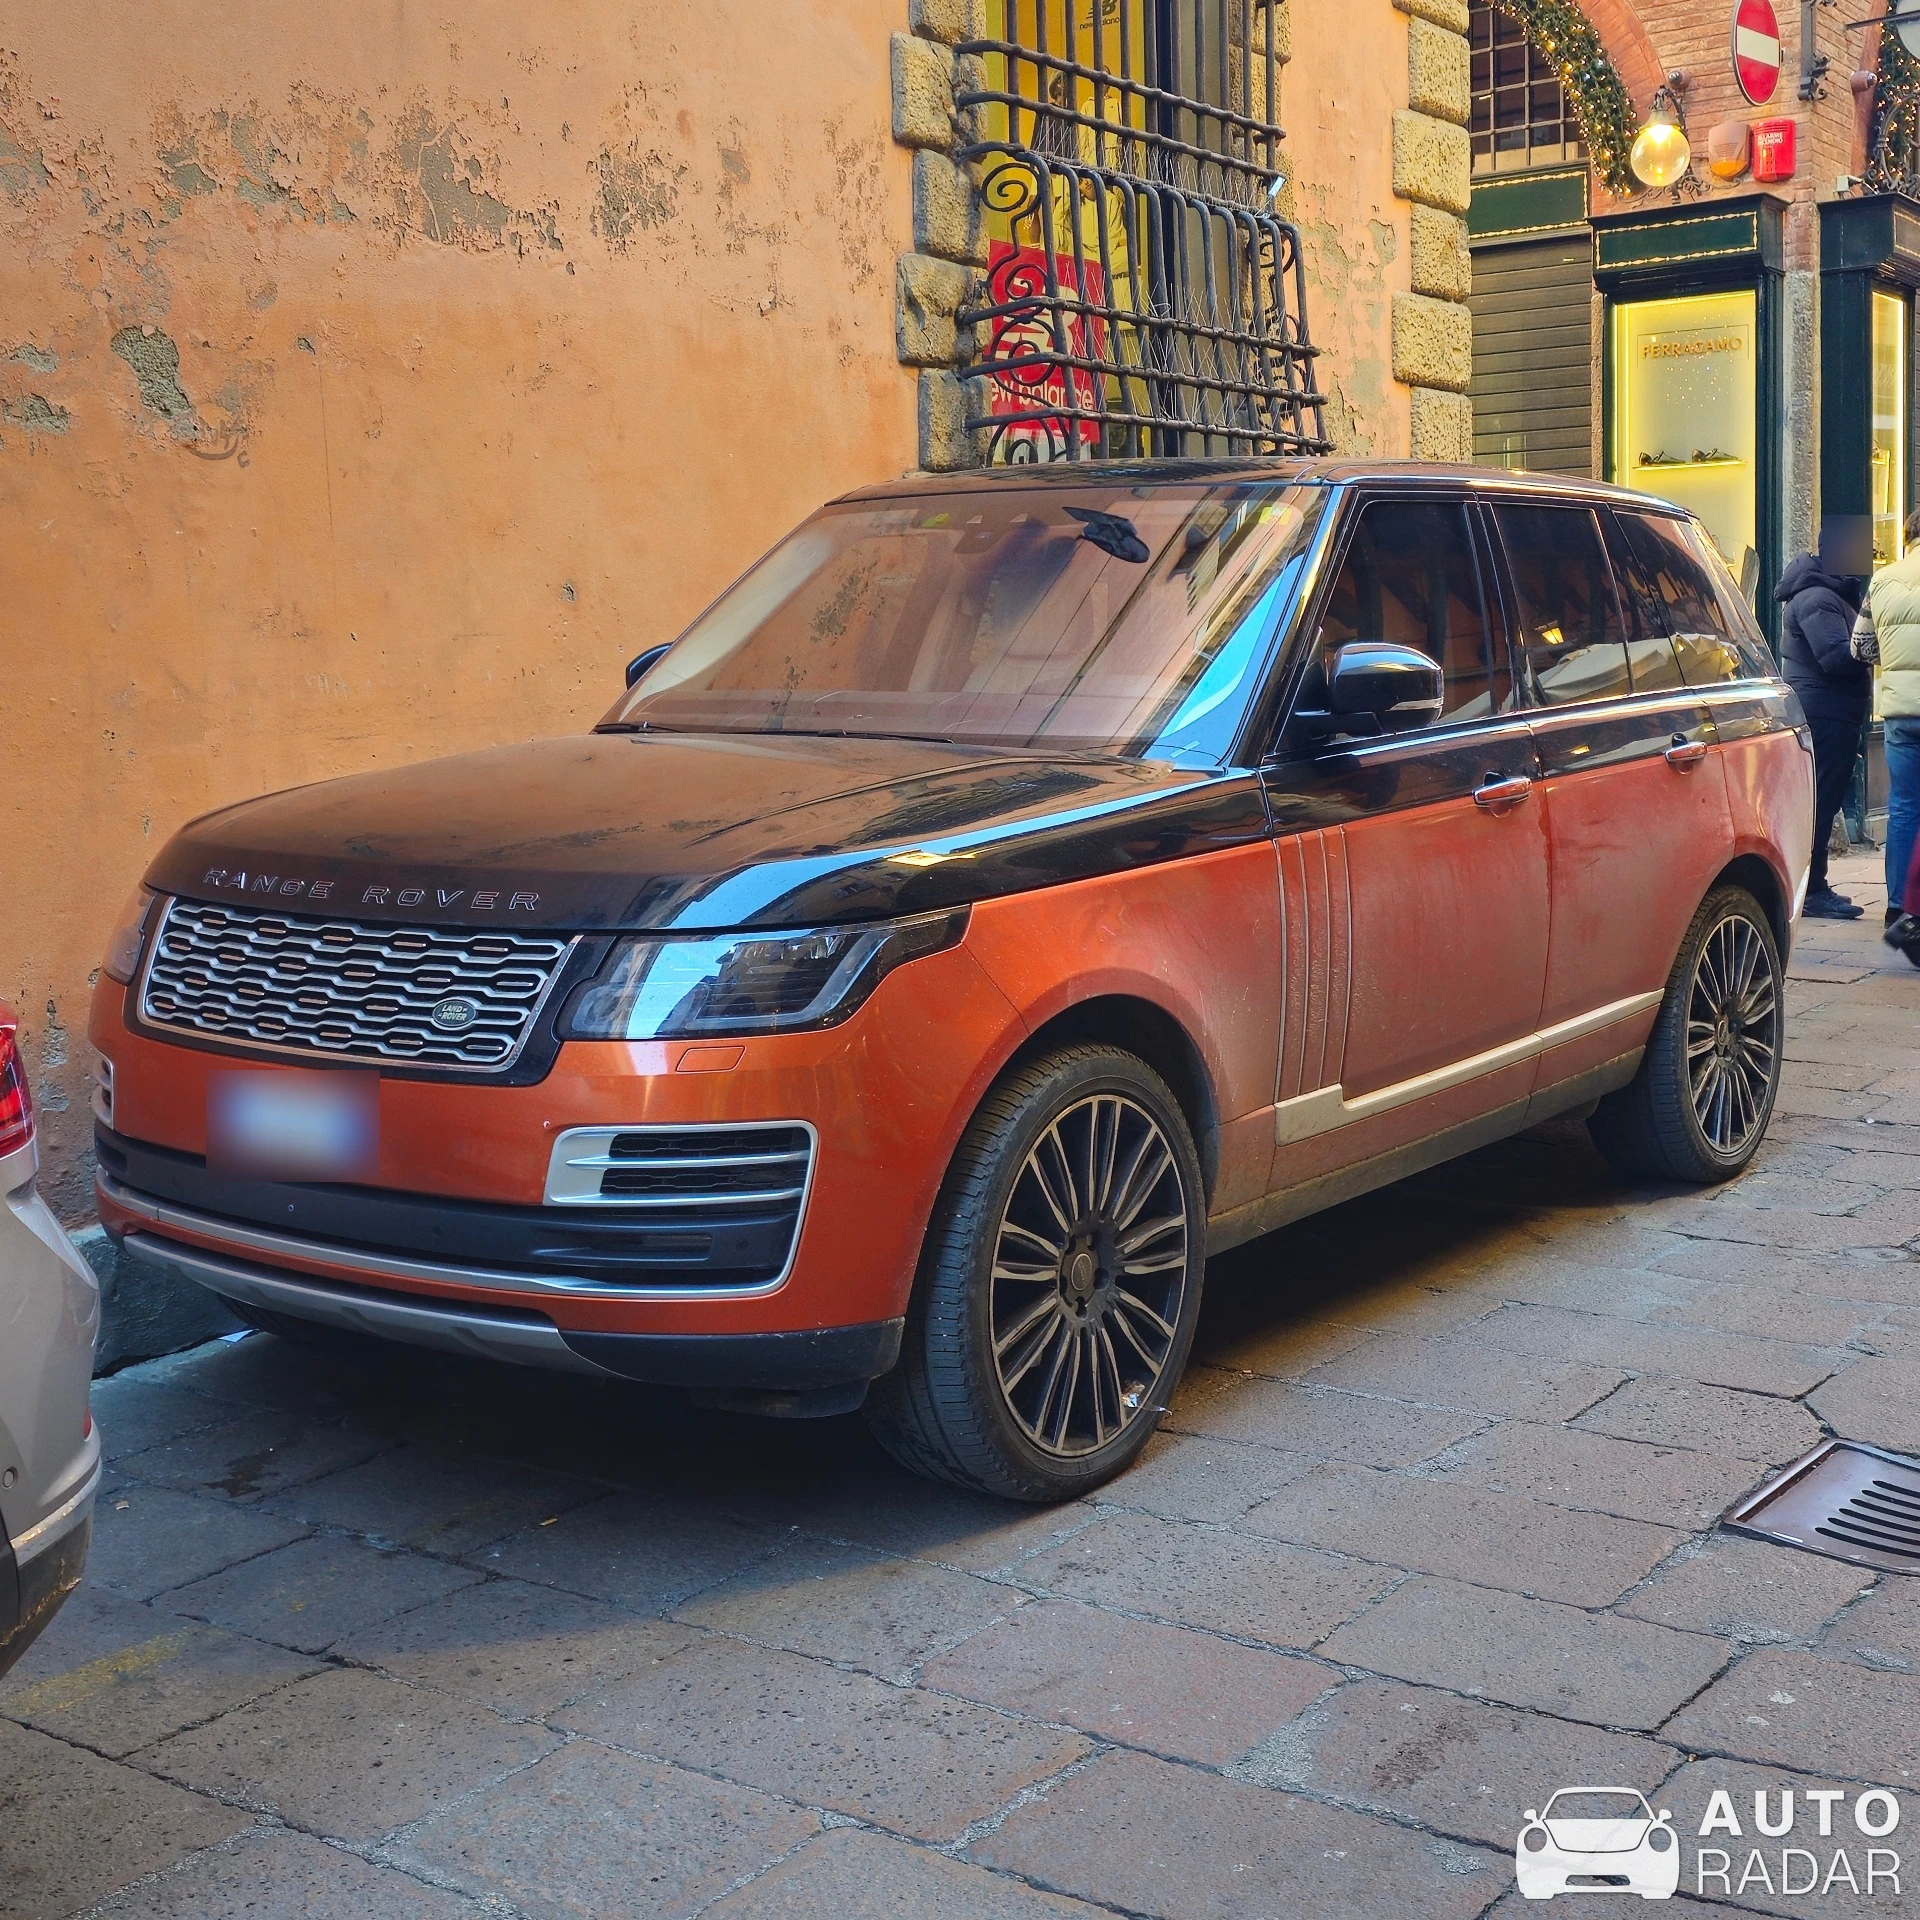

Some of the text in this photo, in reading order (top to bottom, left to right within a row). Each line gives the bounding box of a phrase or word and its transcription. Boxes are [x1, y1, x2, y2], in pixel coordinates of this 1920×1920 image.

[1642, 337, 1744, 359] FERRAGAMO
[991, 377, 1014, 402] ew
[203, 867, 541, 911] RANGE ROVER
[440, 1012, 468, 1021] ROVER
[441, 1004, 463, 1013] LAND
